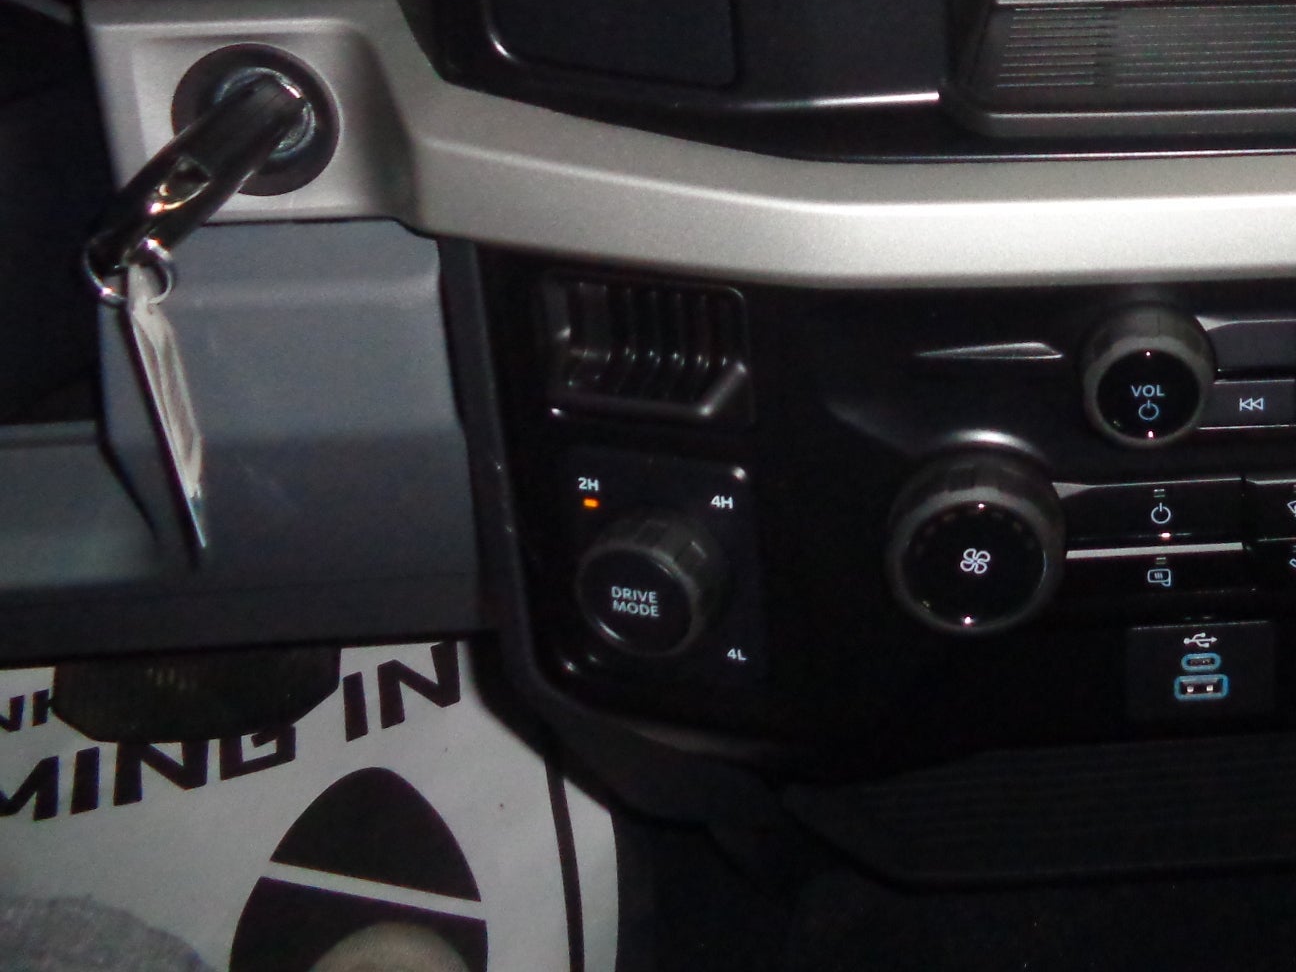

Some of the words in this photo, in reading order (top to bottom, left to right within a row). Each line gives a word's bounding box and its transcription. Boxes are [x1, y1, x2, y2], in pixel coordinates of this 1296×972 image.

[1131, 385, 1165, 397] VOL
[577, 476, 600, 492] 2H
[710, 494, 734, 510] 4H
[611, 586, 657, 603] DRIVE
[612, 600, 660, 618] MODE
[726, 648, 747, 661] 4L
[342, 640, 461, 743] IN
